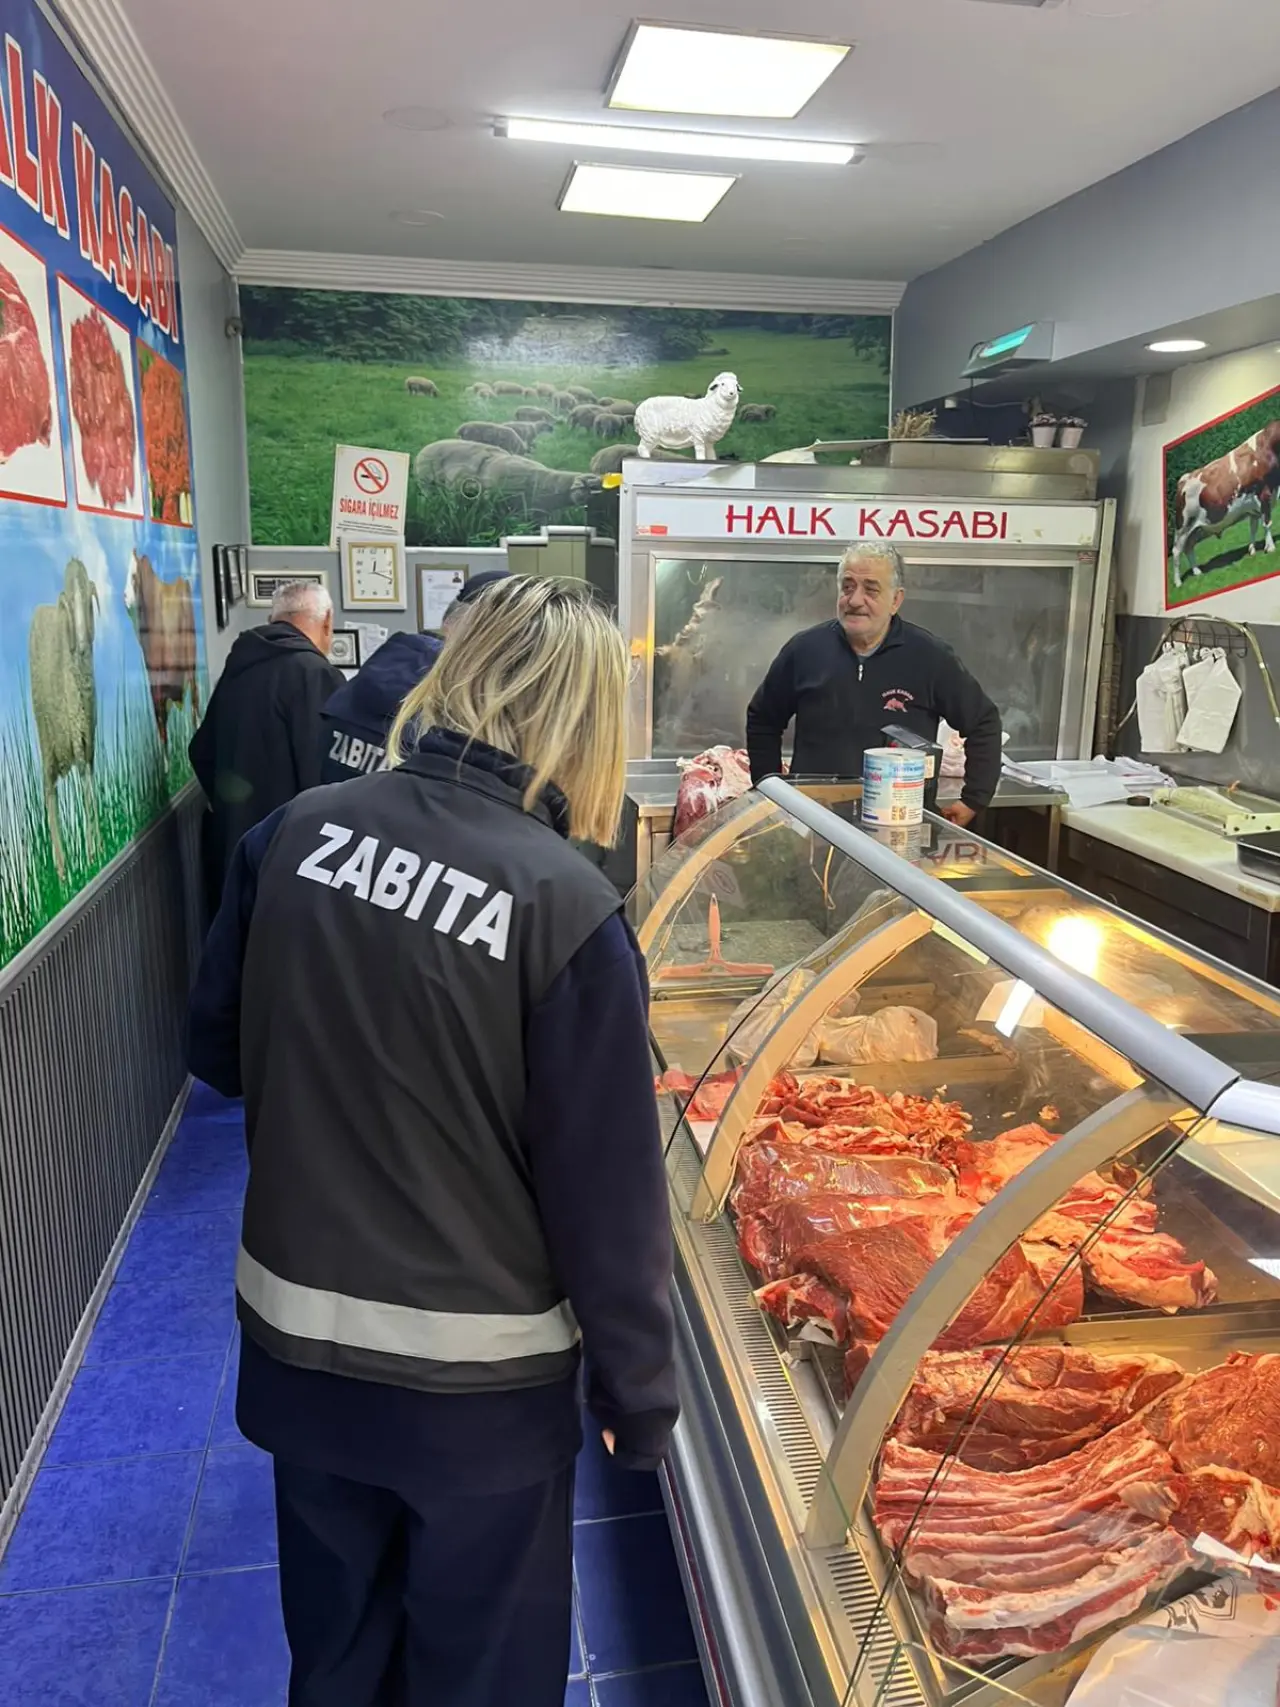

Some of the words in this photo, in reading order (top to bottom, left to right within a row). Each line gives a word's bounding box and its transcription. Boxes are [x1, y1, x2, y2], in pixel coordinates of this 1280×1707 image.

[72, 121, 179, 344] KASABI
[725, 504, 837, 536] HALK
[859, 508, 1008, 539] KASABI
[296, 822, 514, 962] ZABITA
